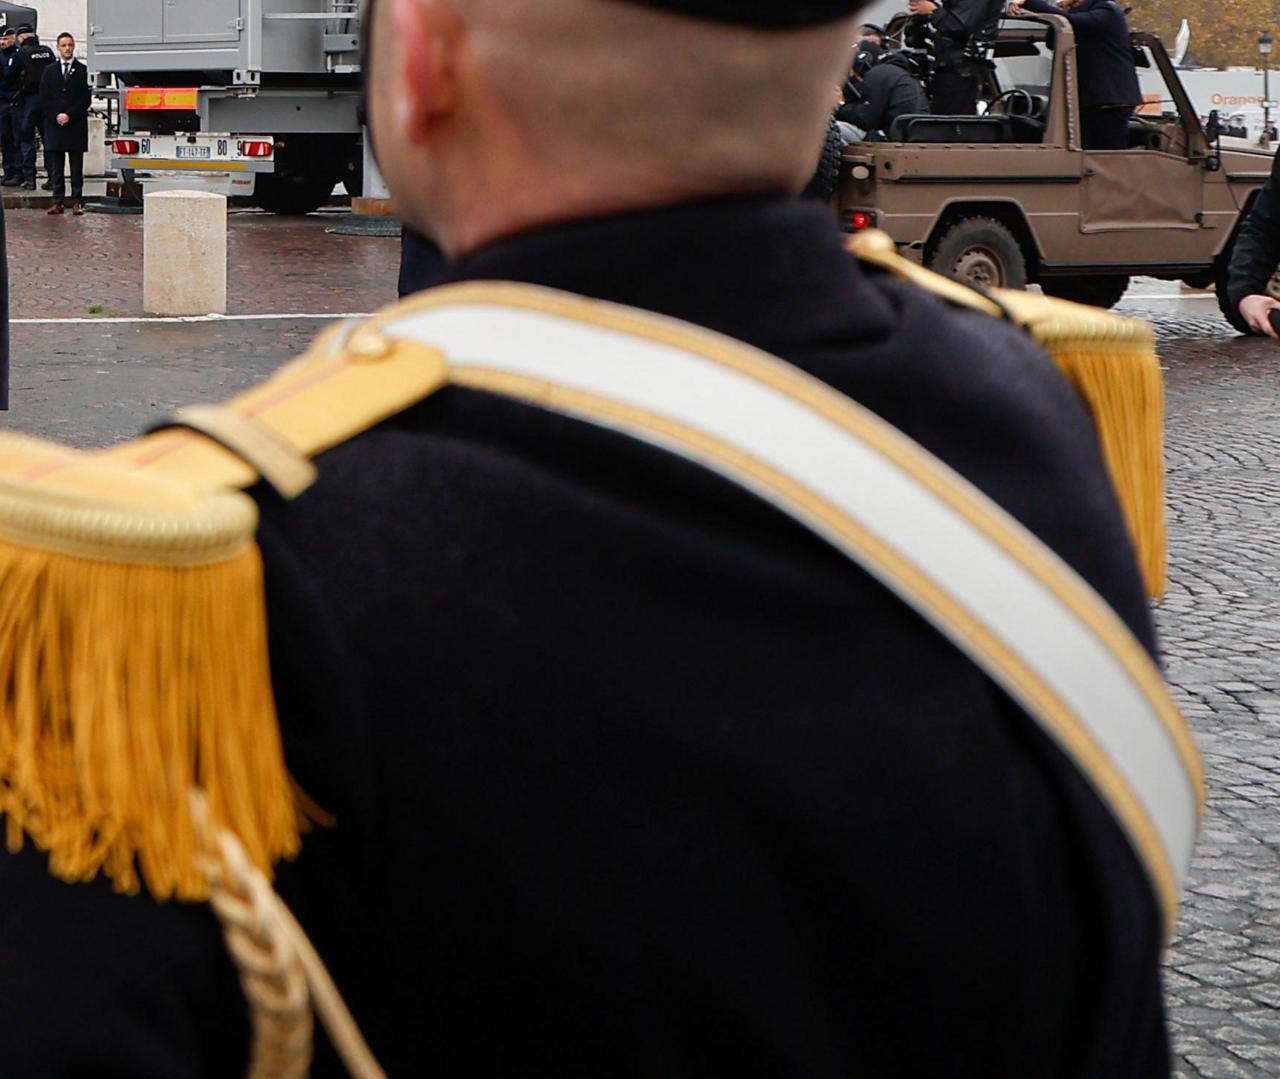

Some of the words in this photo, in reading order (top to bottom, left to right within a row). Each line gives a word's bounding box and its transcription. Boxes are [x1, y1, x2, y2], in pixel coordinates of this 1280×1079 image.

[141, 138, 151, 154] 60
[217, 140, 228, 156] 80
[237, 140, 244, 156] 9
